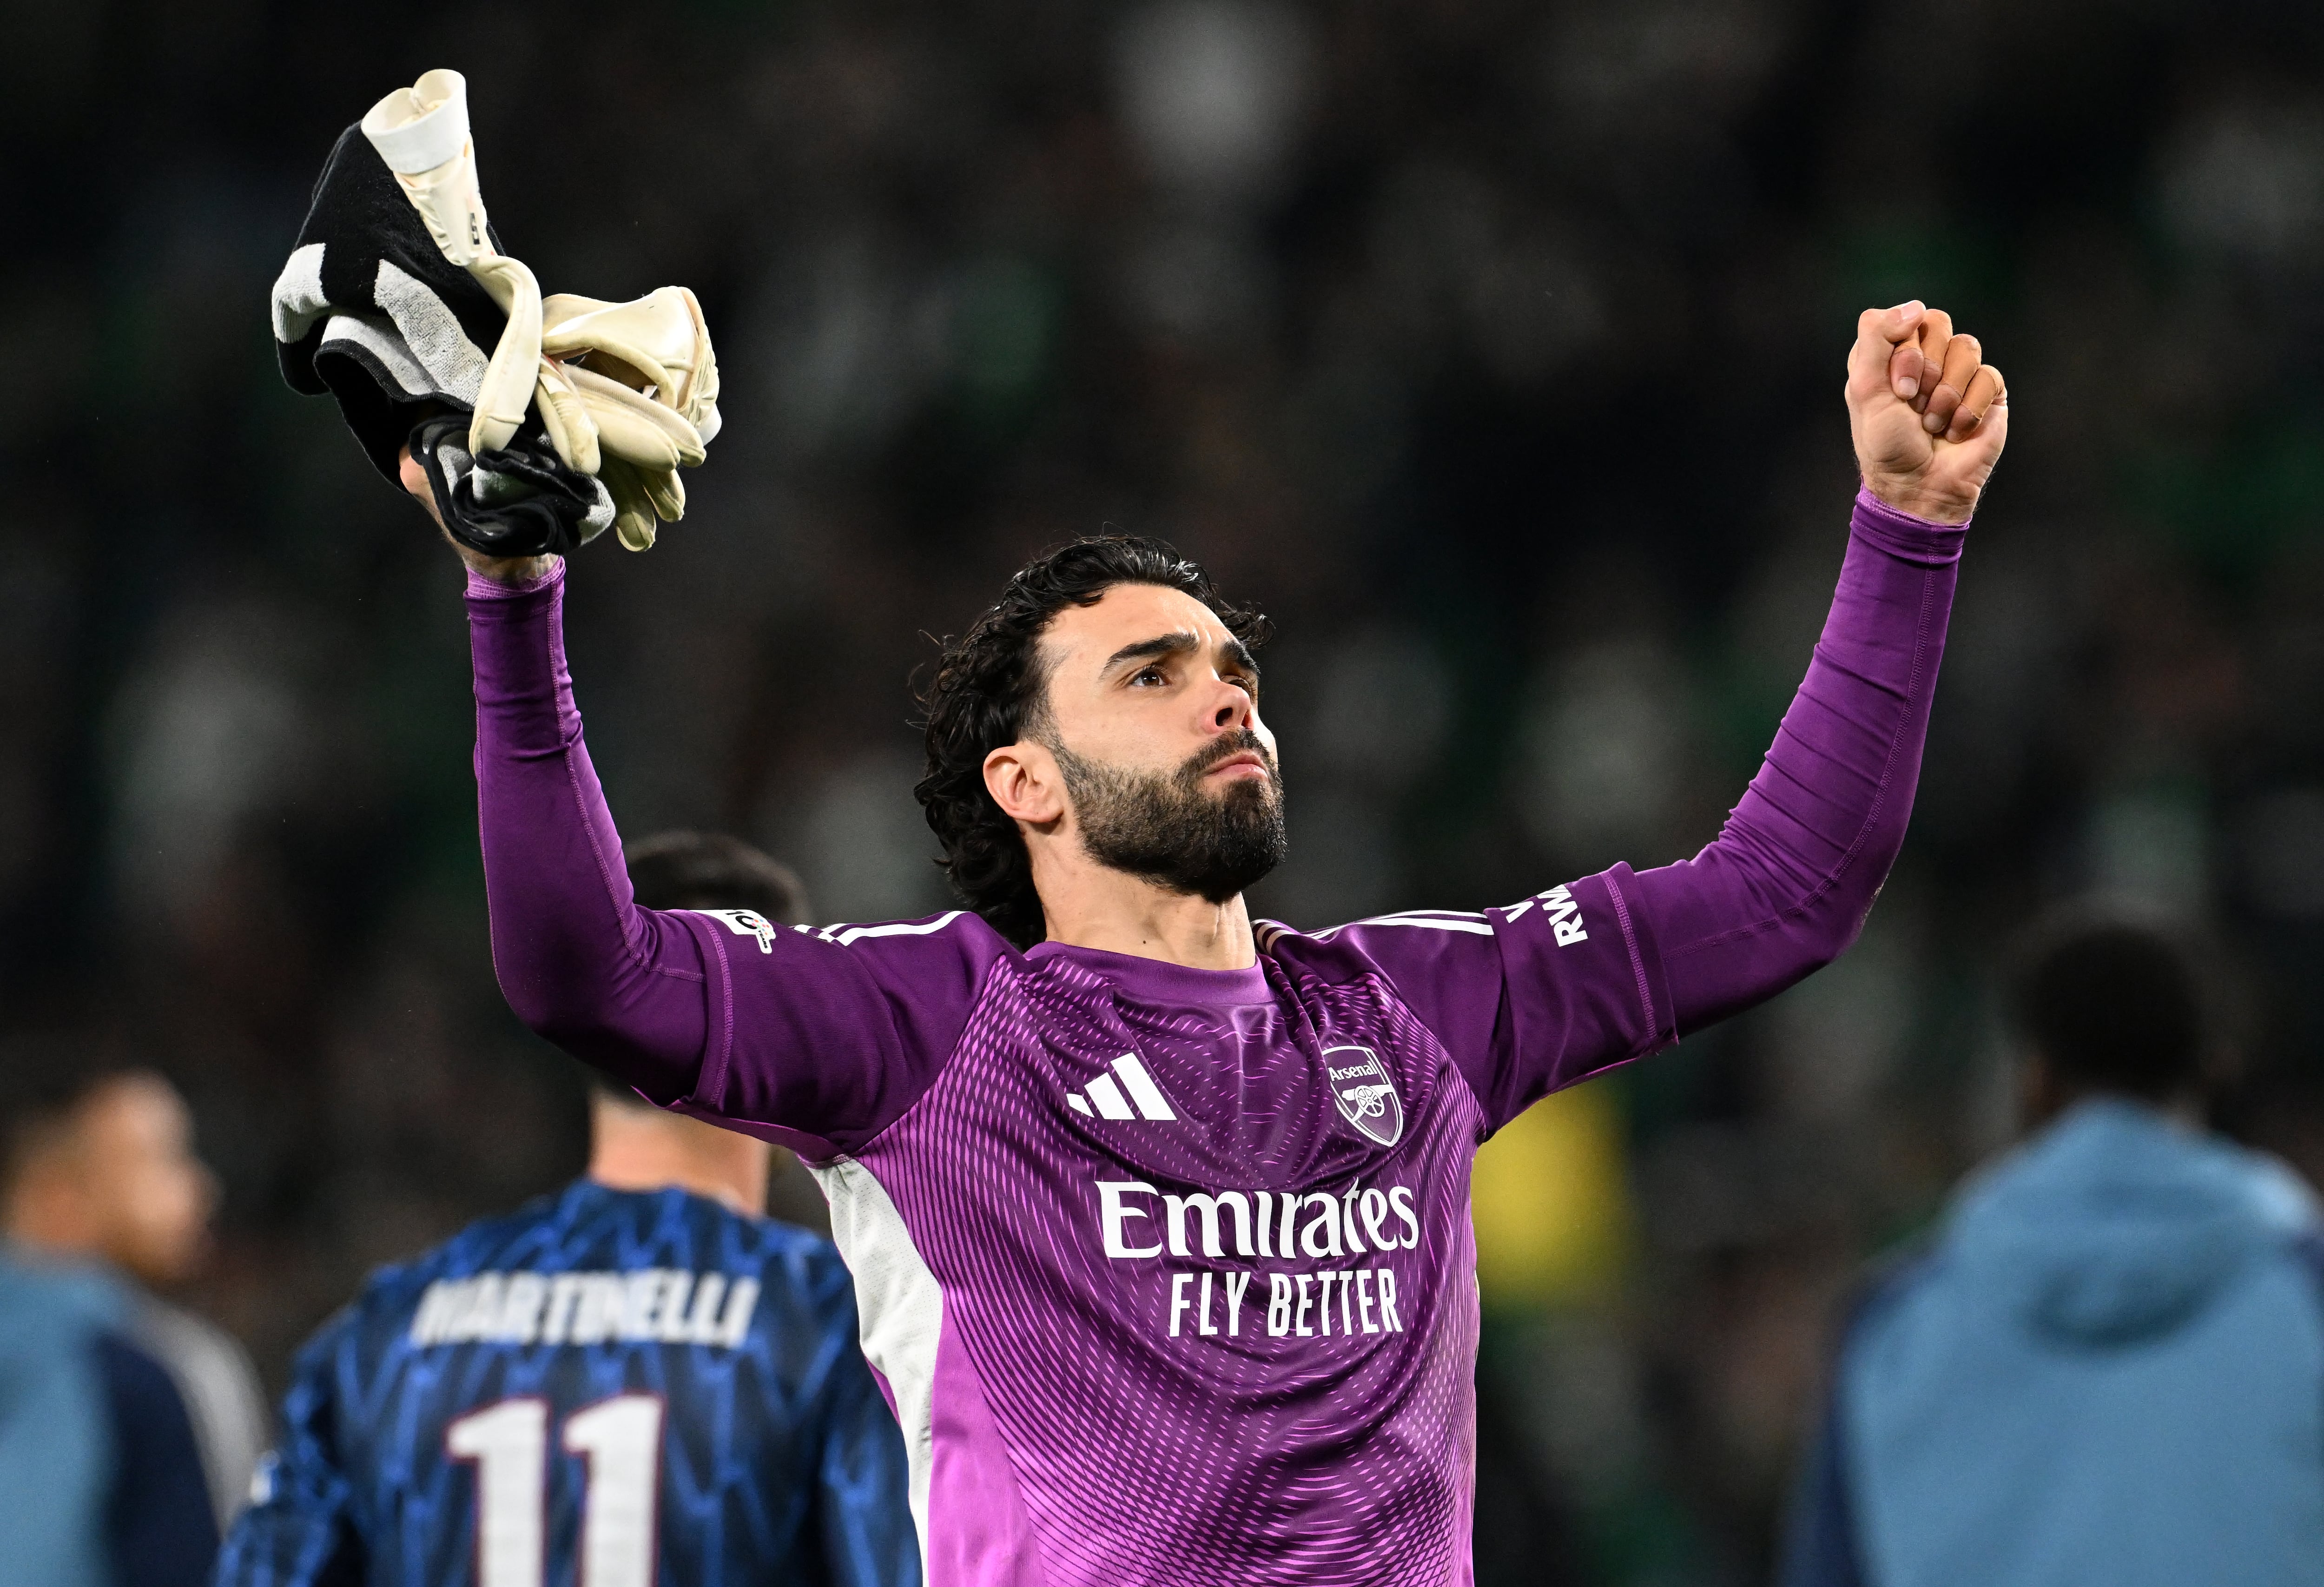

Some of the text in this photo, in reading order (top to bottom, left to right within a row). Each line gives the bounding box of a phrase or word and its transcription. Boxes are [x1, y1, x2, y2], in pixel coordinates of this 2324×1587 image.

[758, 930, 768, 949] YEARS
[1500, 900, 1534, 924] V
[1537, 884, 1588, 947] RW
[1328, 1060, 1377, 1082] Arsenal
[1095, 1177, 1419, 1259] Emirates
[409, 1269, 759, 1348] MARTINELLI
[1169, 1269, 1403, 1337] FLY BETTER
[445, 1389, 664, 1587] 11
